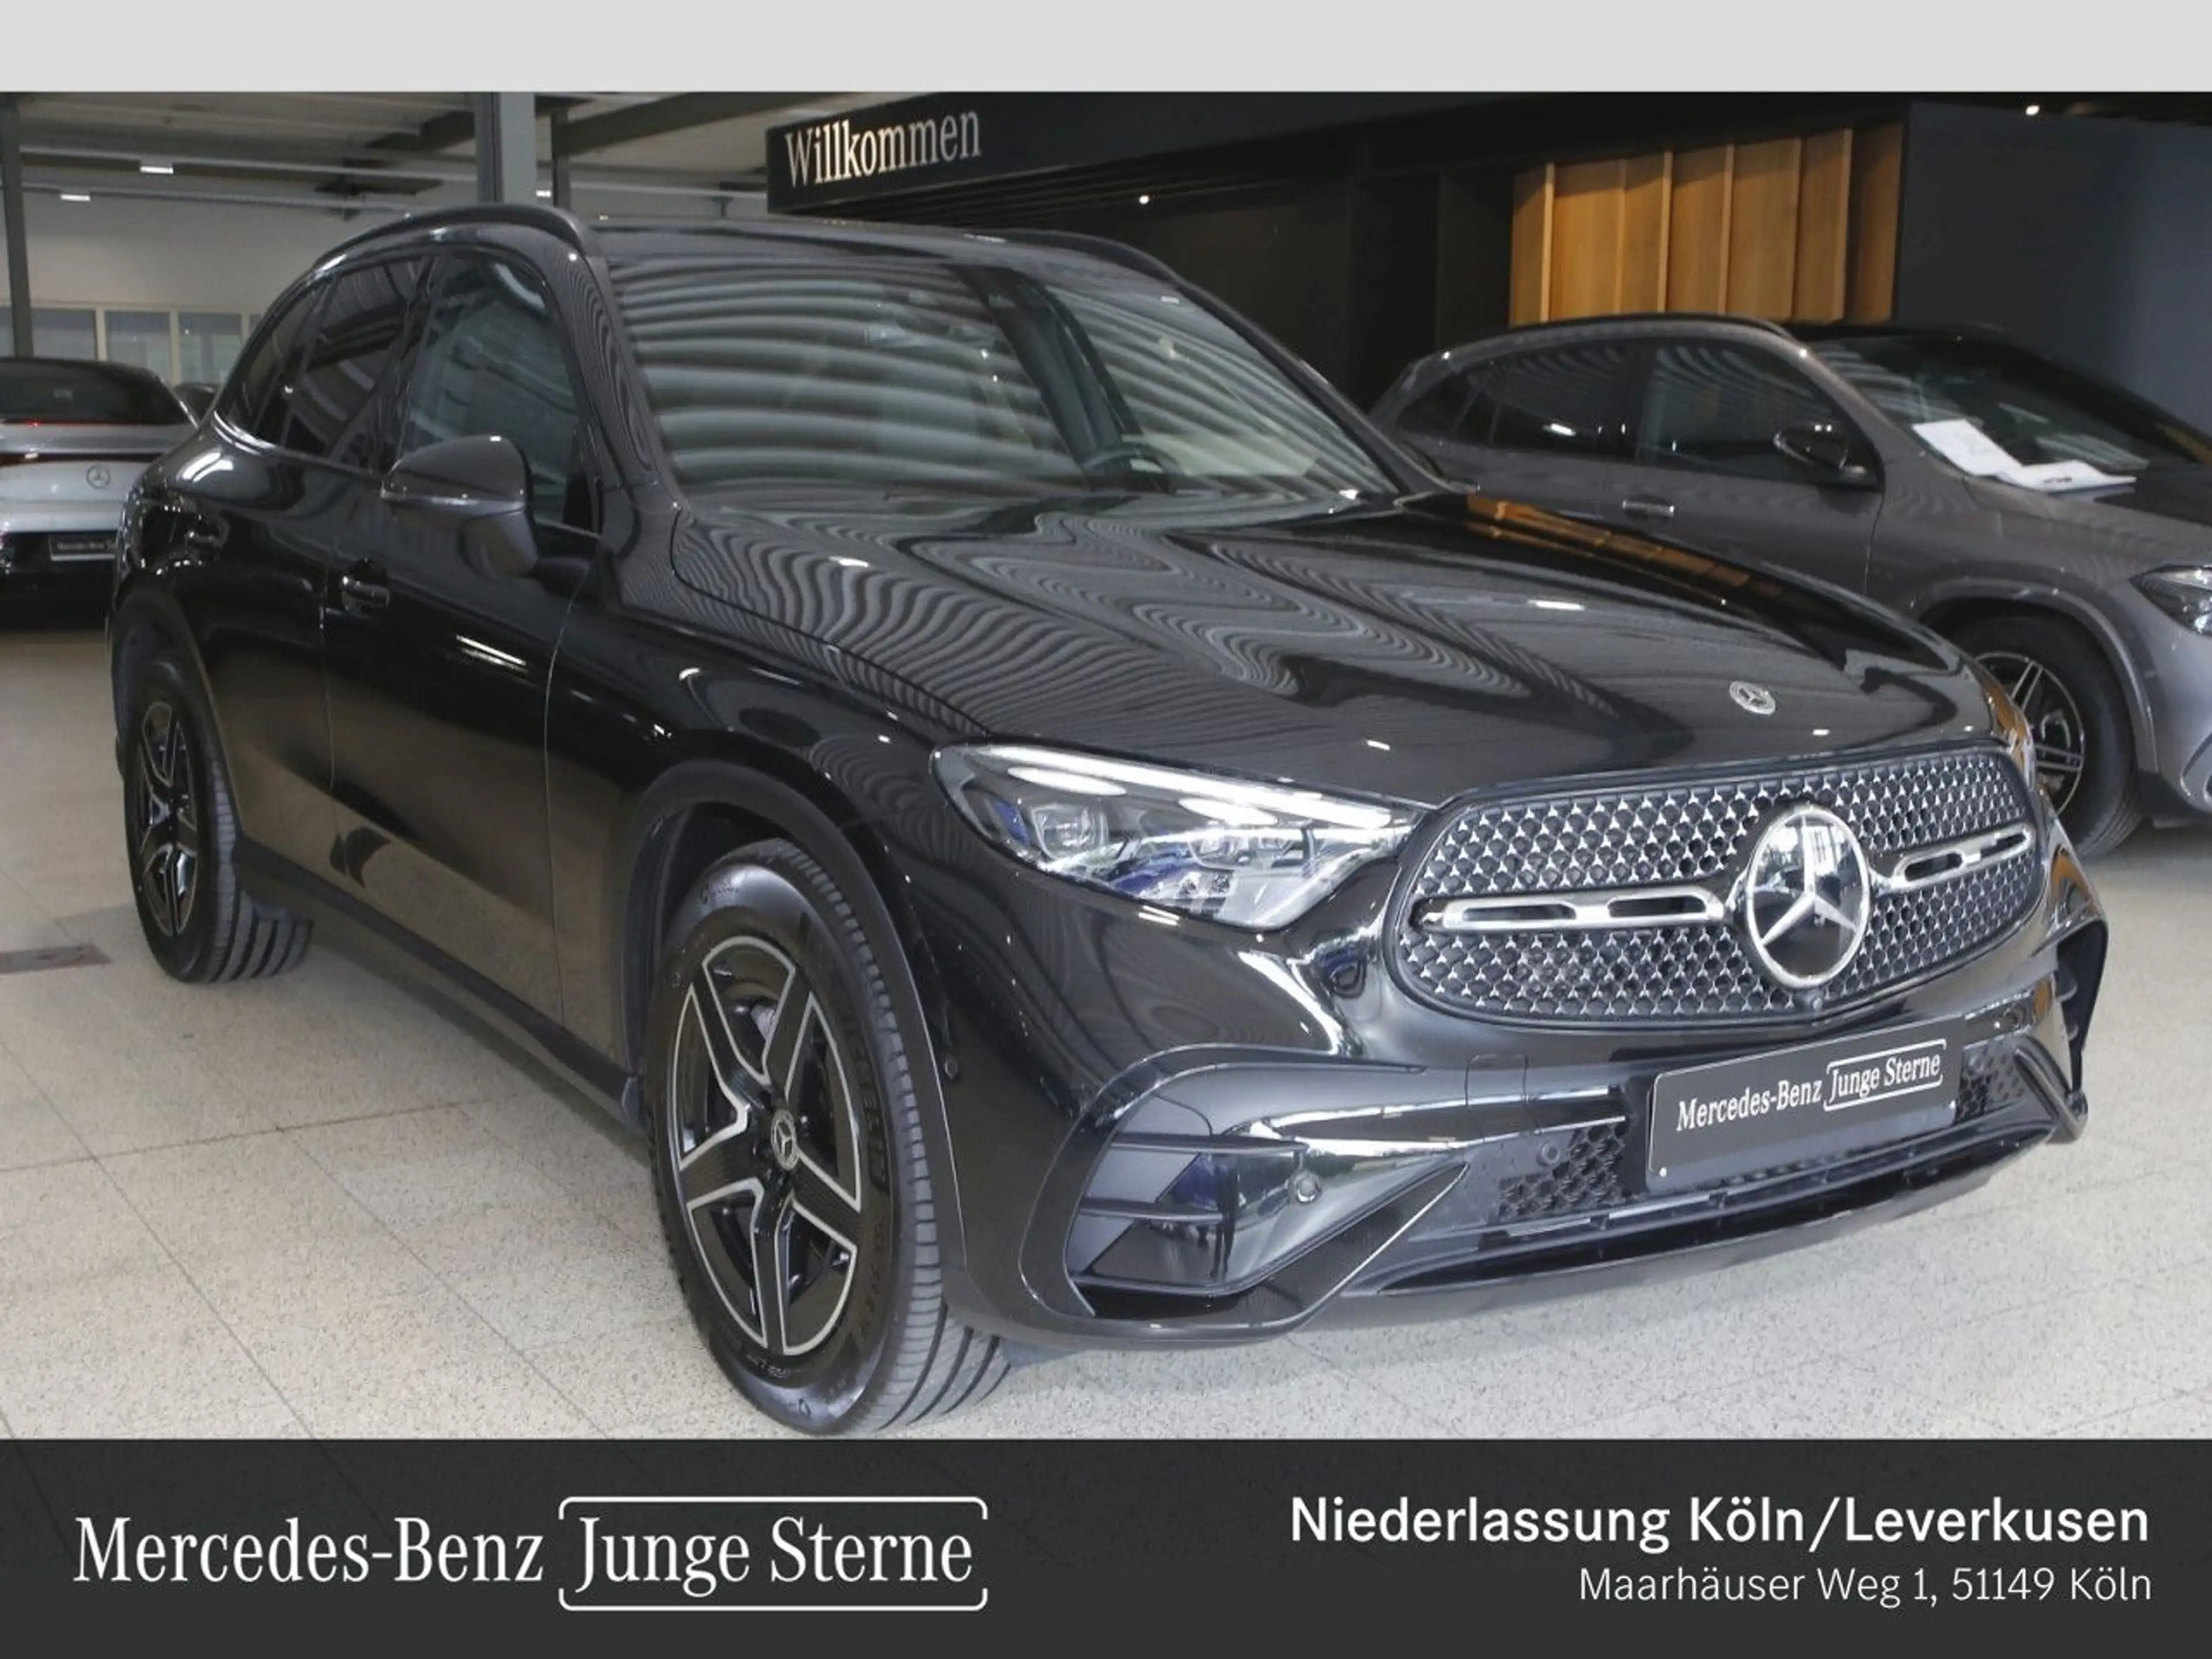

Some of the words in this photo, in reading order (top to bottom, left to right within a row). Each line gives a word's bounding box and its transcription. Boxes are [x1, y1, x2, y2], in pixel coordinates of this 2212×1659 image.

[785, 110, 981, 188] Willkommen
[1676, 1079, 1823, 1131] Mercedes-Benz
[1828, 1066, 1880, 1103] Junge
[1884, 1055, 1941, 1088] Sterne
